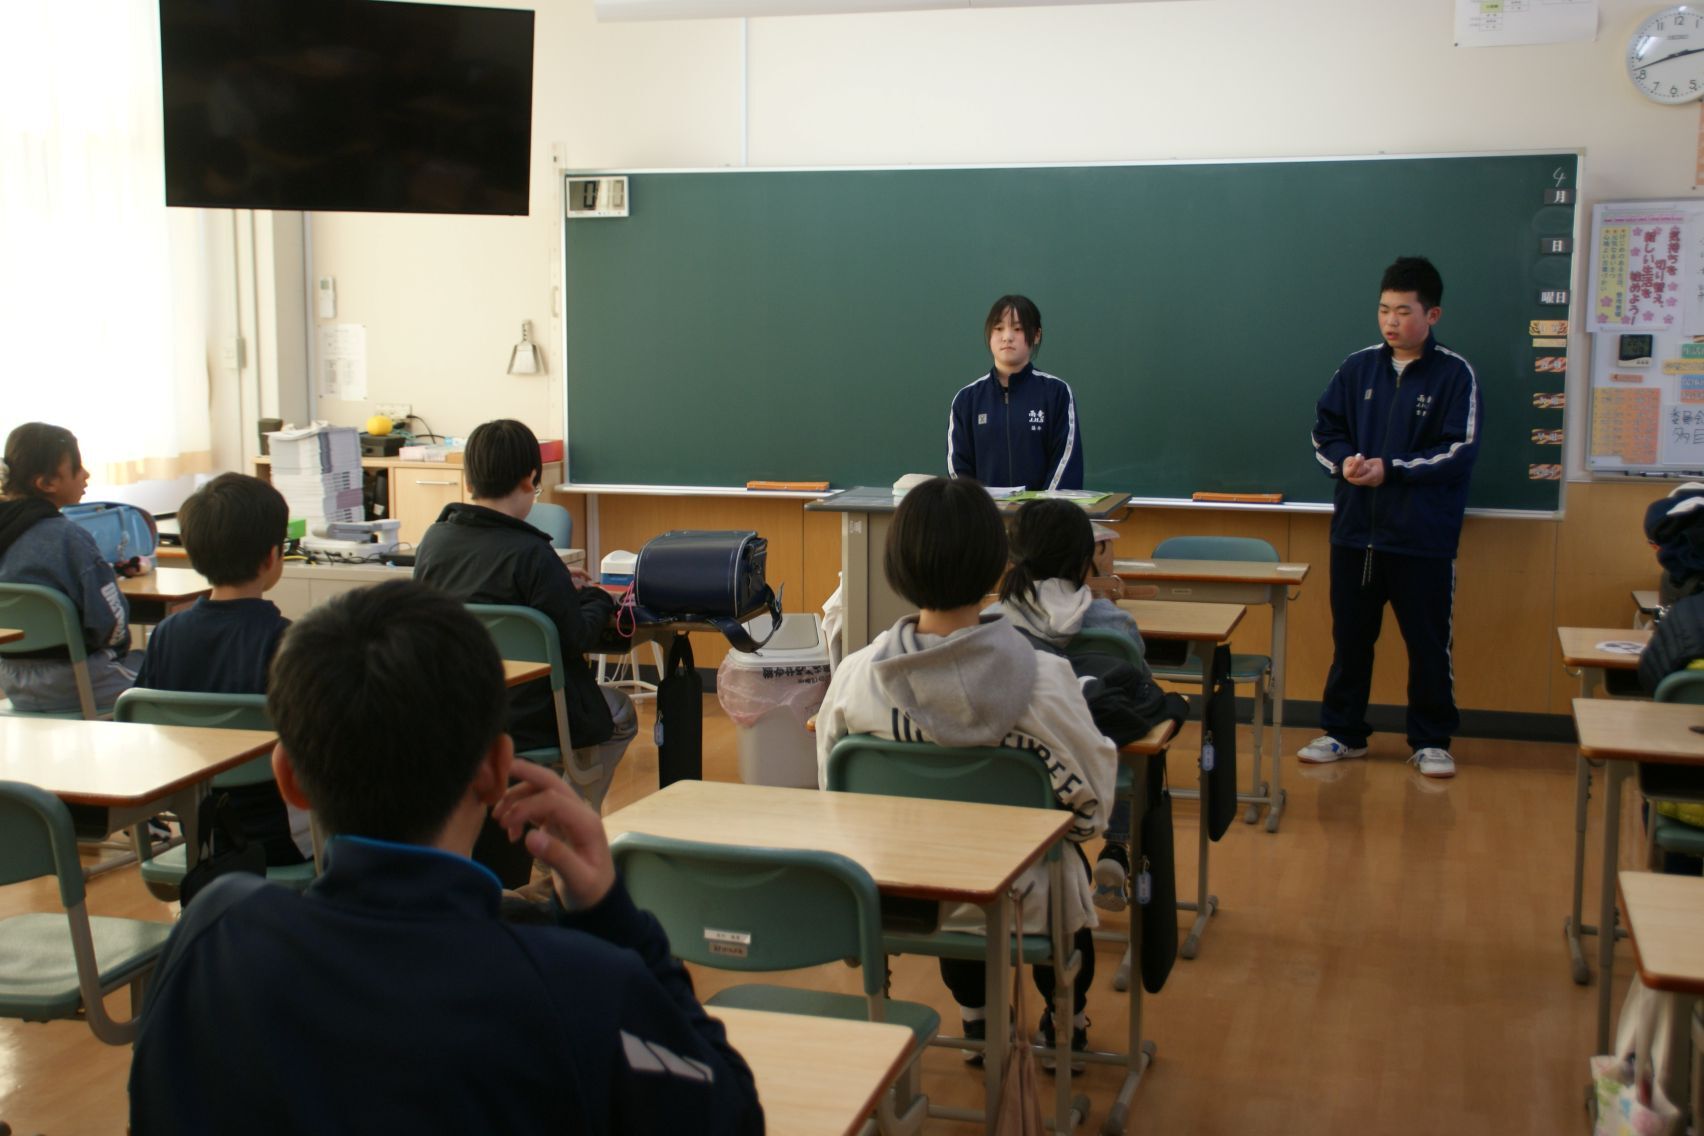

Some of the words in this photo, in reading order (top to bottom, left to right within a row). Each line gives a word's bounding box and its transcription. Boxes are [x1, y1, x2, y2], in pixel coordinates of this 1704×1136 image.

[1656, 21, 1664, 31] 11
[1674, 16, 1684, 26] 12
[1639, 69, 1647, 80] 8
[1653, 81, 1660, 91] 7
[1670, 85, 1678, 96] 6
[1689, 80, 1697, 92] 5
[1552, 166, 1567, 188] 4
[1554, 190, 1566, 204] 月
[1552, 239, 1563, 253] 日
[1667, 230, 1680, 276] 気持ちを
[1641, 231, 1656, 299] 新しい生活を
[1541, 291, 1566, 304] 曜日
